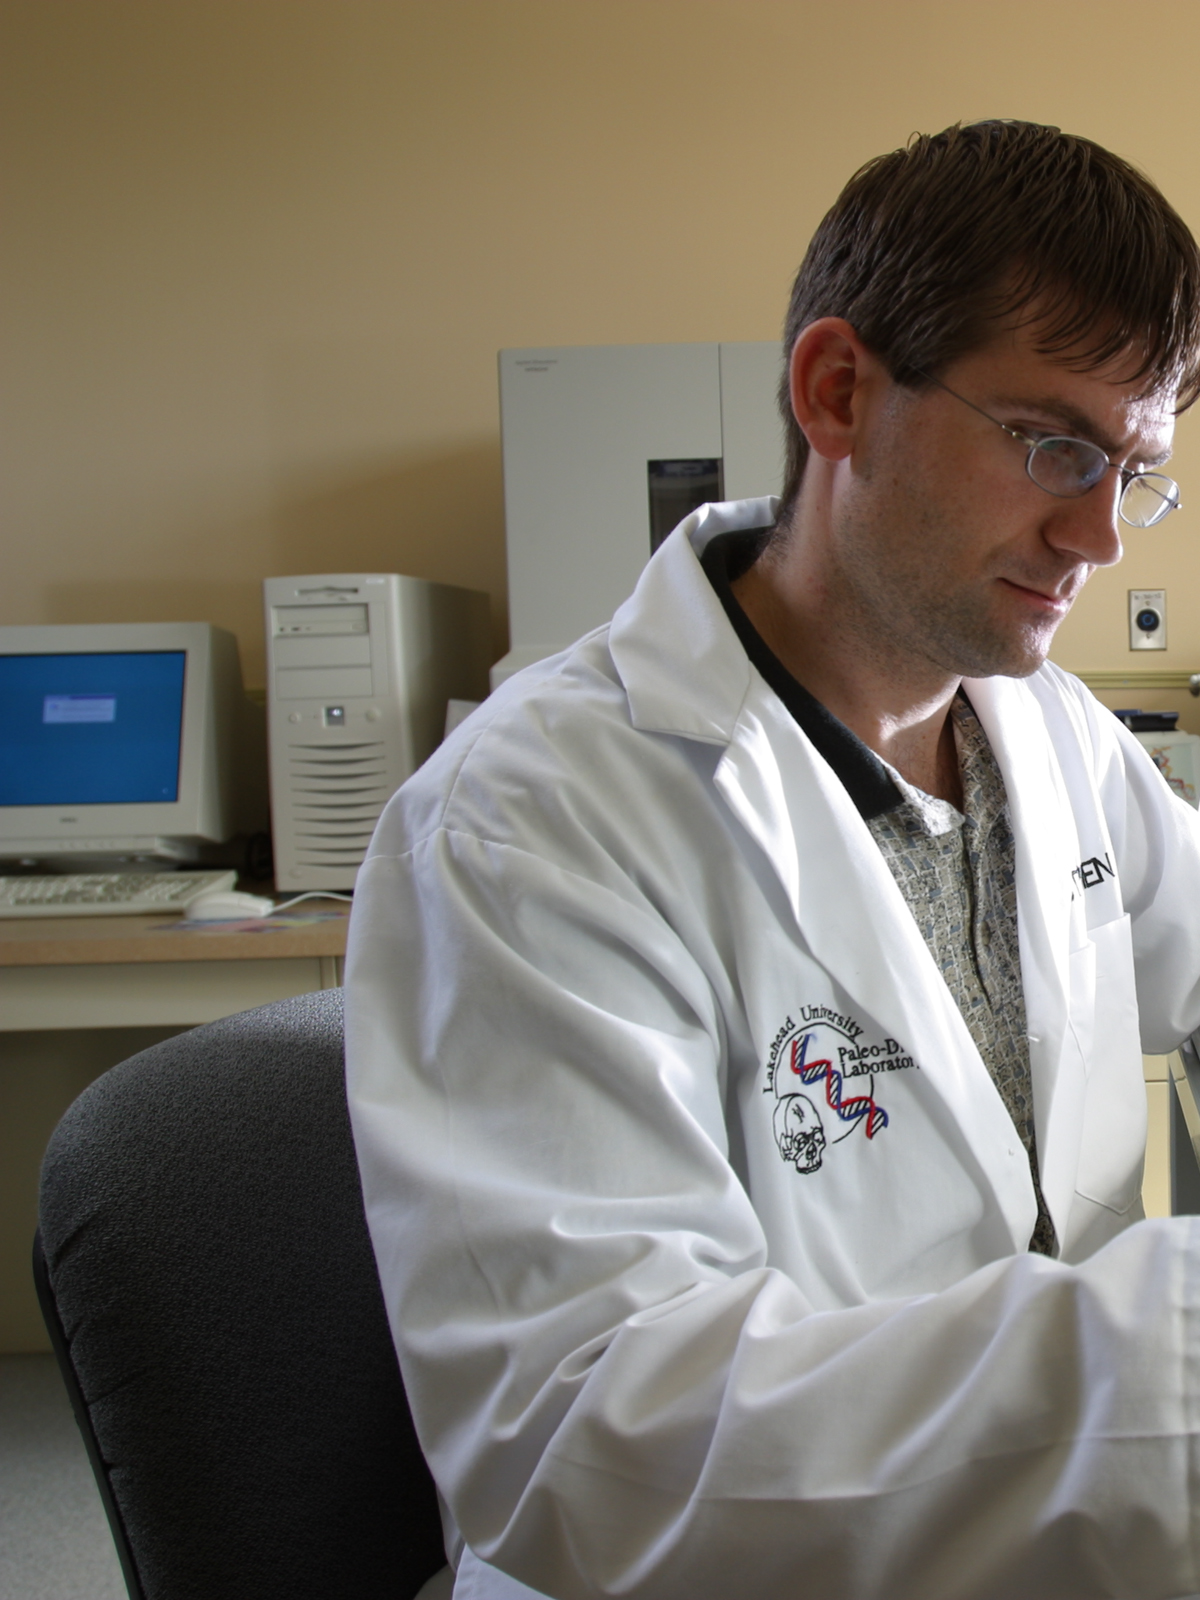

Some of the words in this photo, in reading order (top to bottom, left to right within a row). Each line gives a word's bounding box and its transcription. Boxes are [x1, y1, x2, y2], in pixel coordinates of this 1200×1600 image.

[763, 1015, 796, 1094] Lakehead
[799, 1004, 865, 1039] University
[837, 1038, 905, 1063] Paleo-D
[841, 1055, 921, 1079] Laborator
